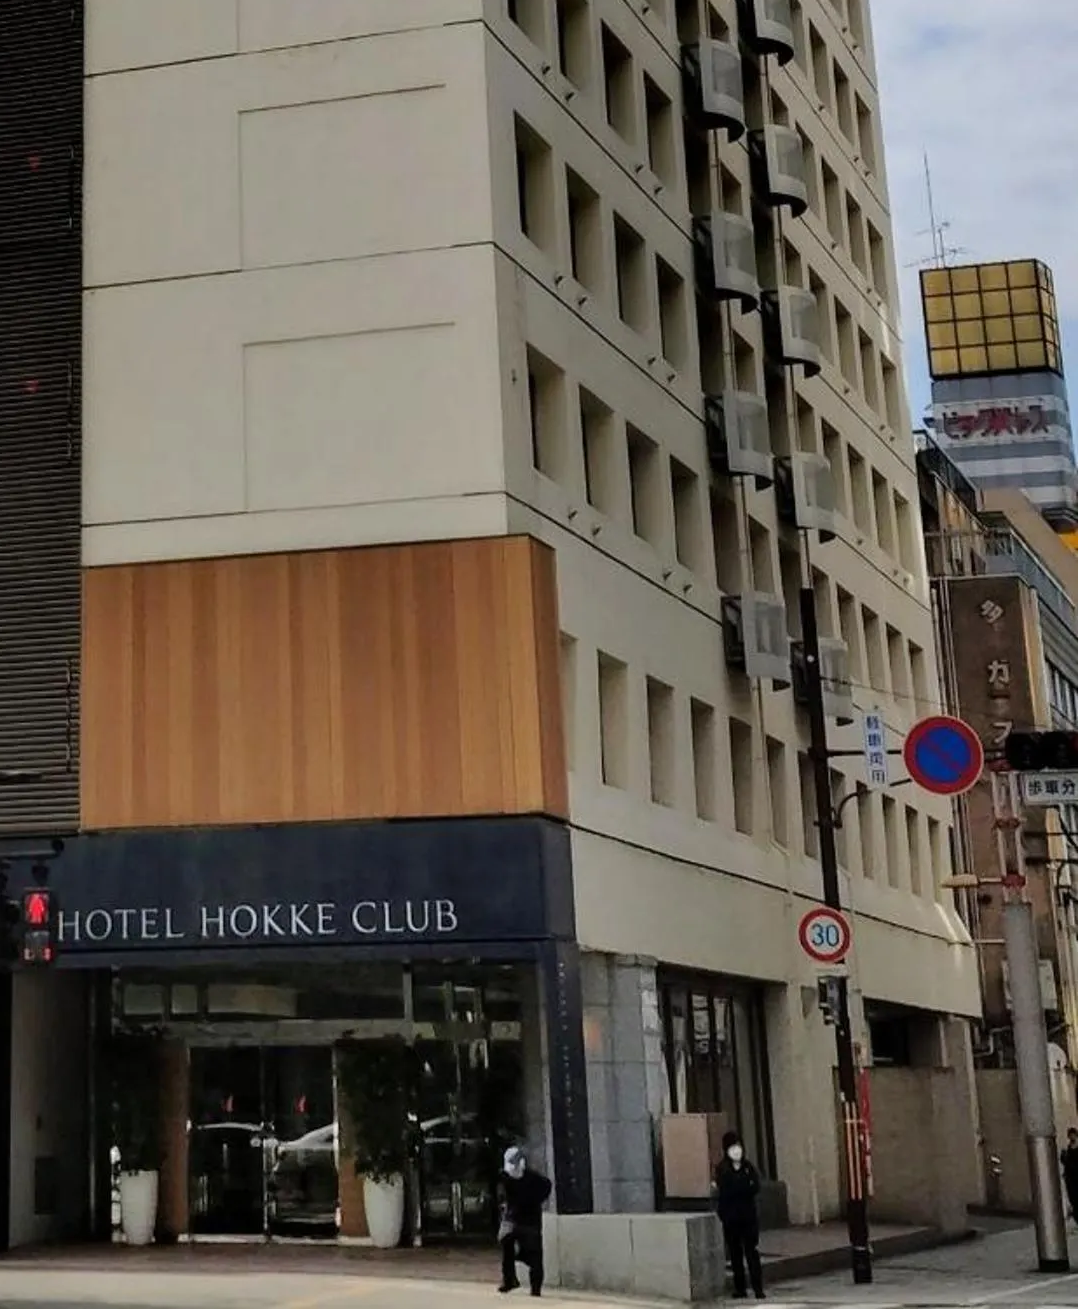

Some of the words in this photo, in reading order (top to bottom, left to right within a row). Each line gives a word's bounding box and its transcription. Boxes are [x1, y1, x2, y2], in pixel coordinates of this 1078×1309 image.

[57, 908, 184, 941] HOTEL
[201, 903, 337, 939] HOKKE
[352, 899, 459, 934] CLUB
[811, 923, 839, 947] 30
